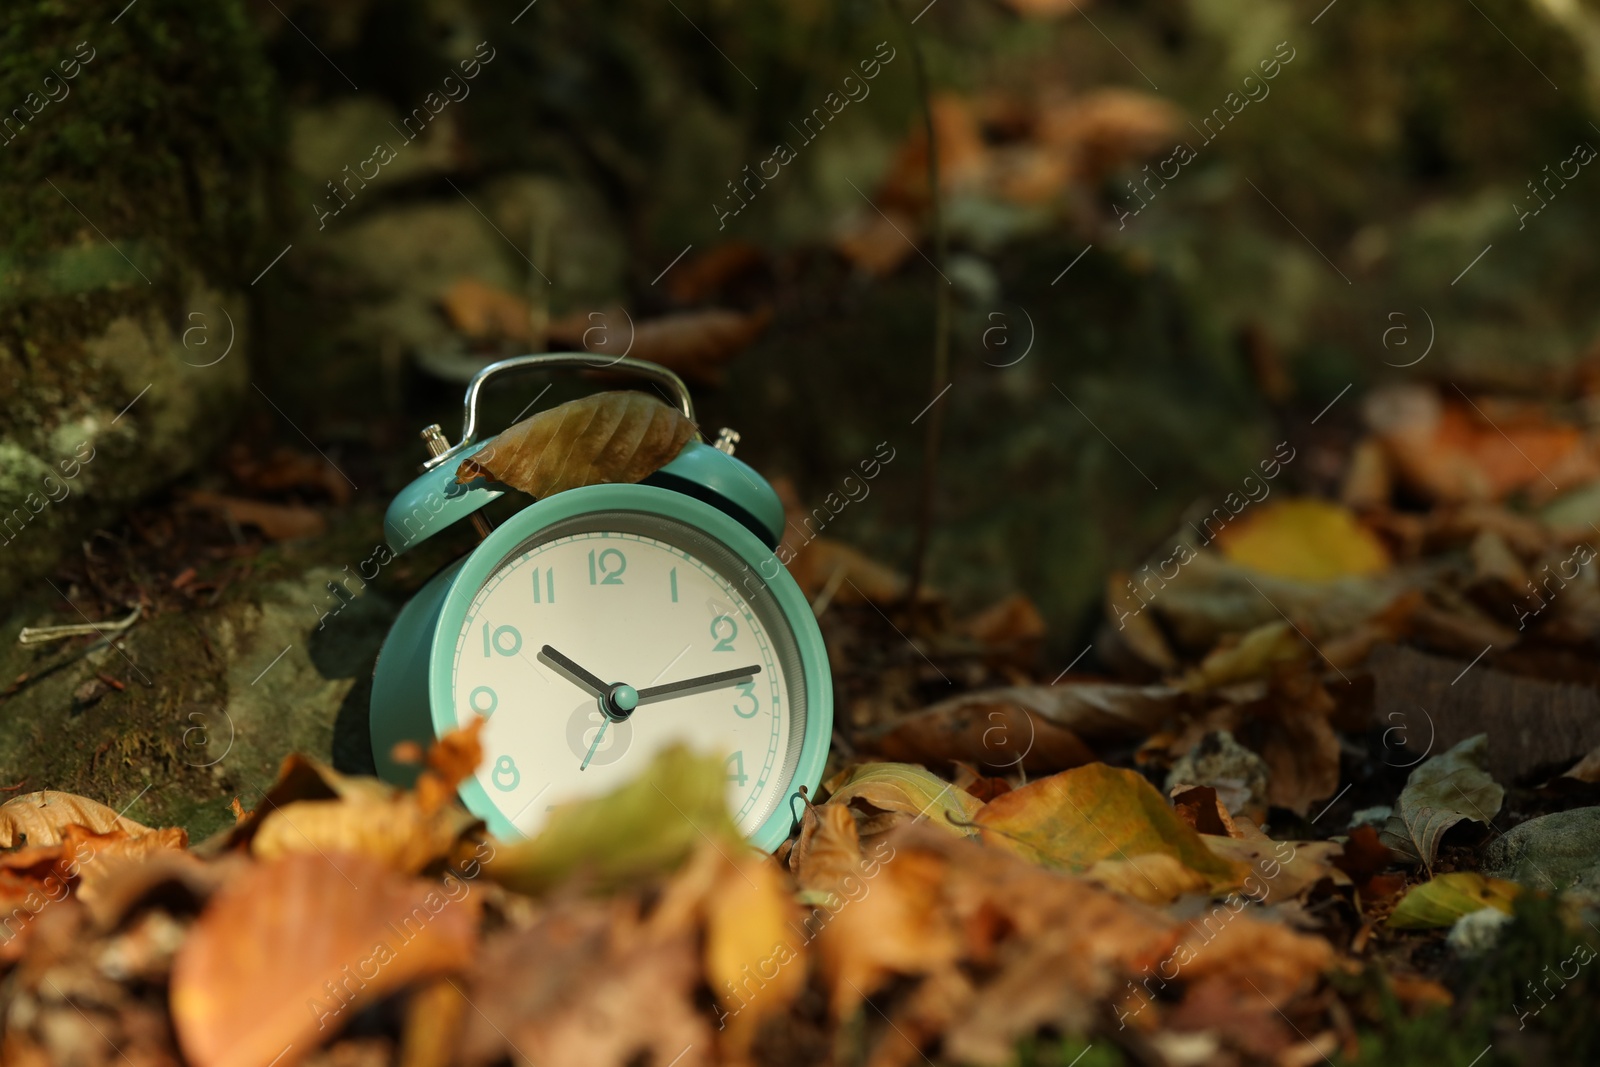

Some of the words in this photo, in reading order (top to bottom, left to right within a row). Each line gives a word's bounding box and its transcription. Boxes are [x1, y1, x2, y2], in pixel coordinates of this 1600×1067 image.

[587, 547, 627, 585] 12
[669, 566, 679, 603] 1
[532, 566, 555, 604] 11
[482, 620, 522, 658] 10
[710, 615, 739, 651] 2
[733, 682, 760, 719] 3
[491, 755, 521, 792] 8
